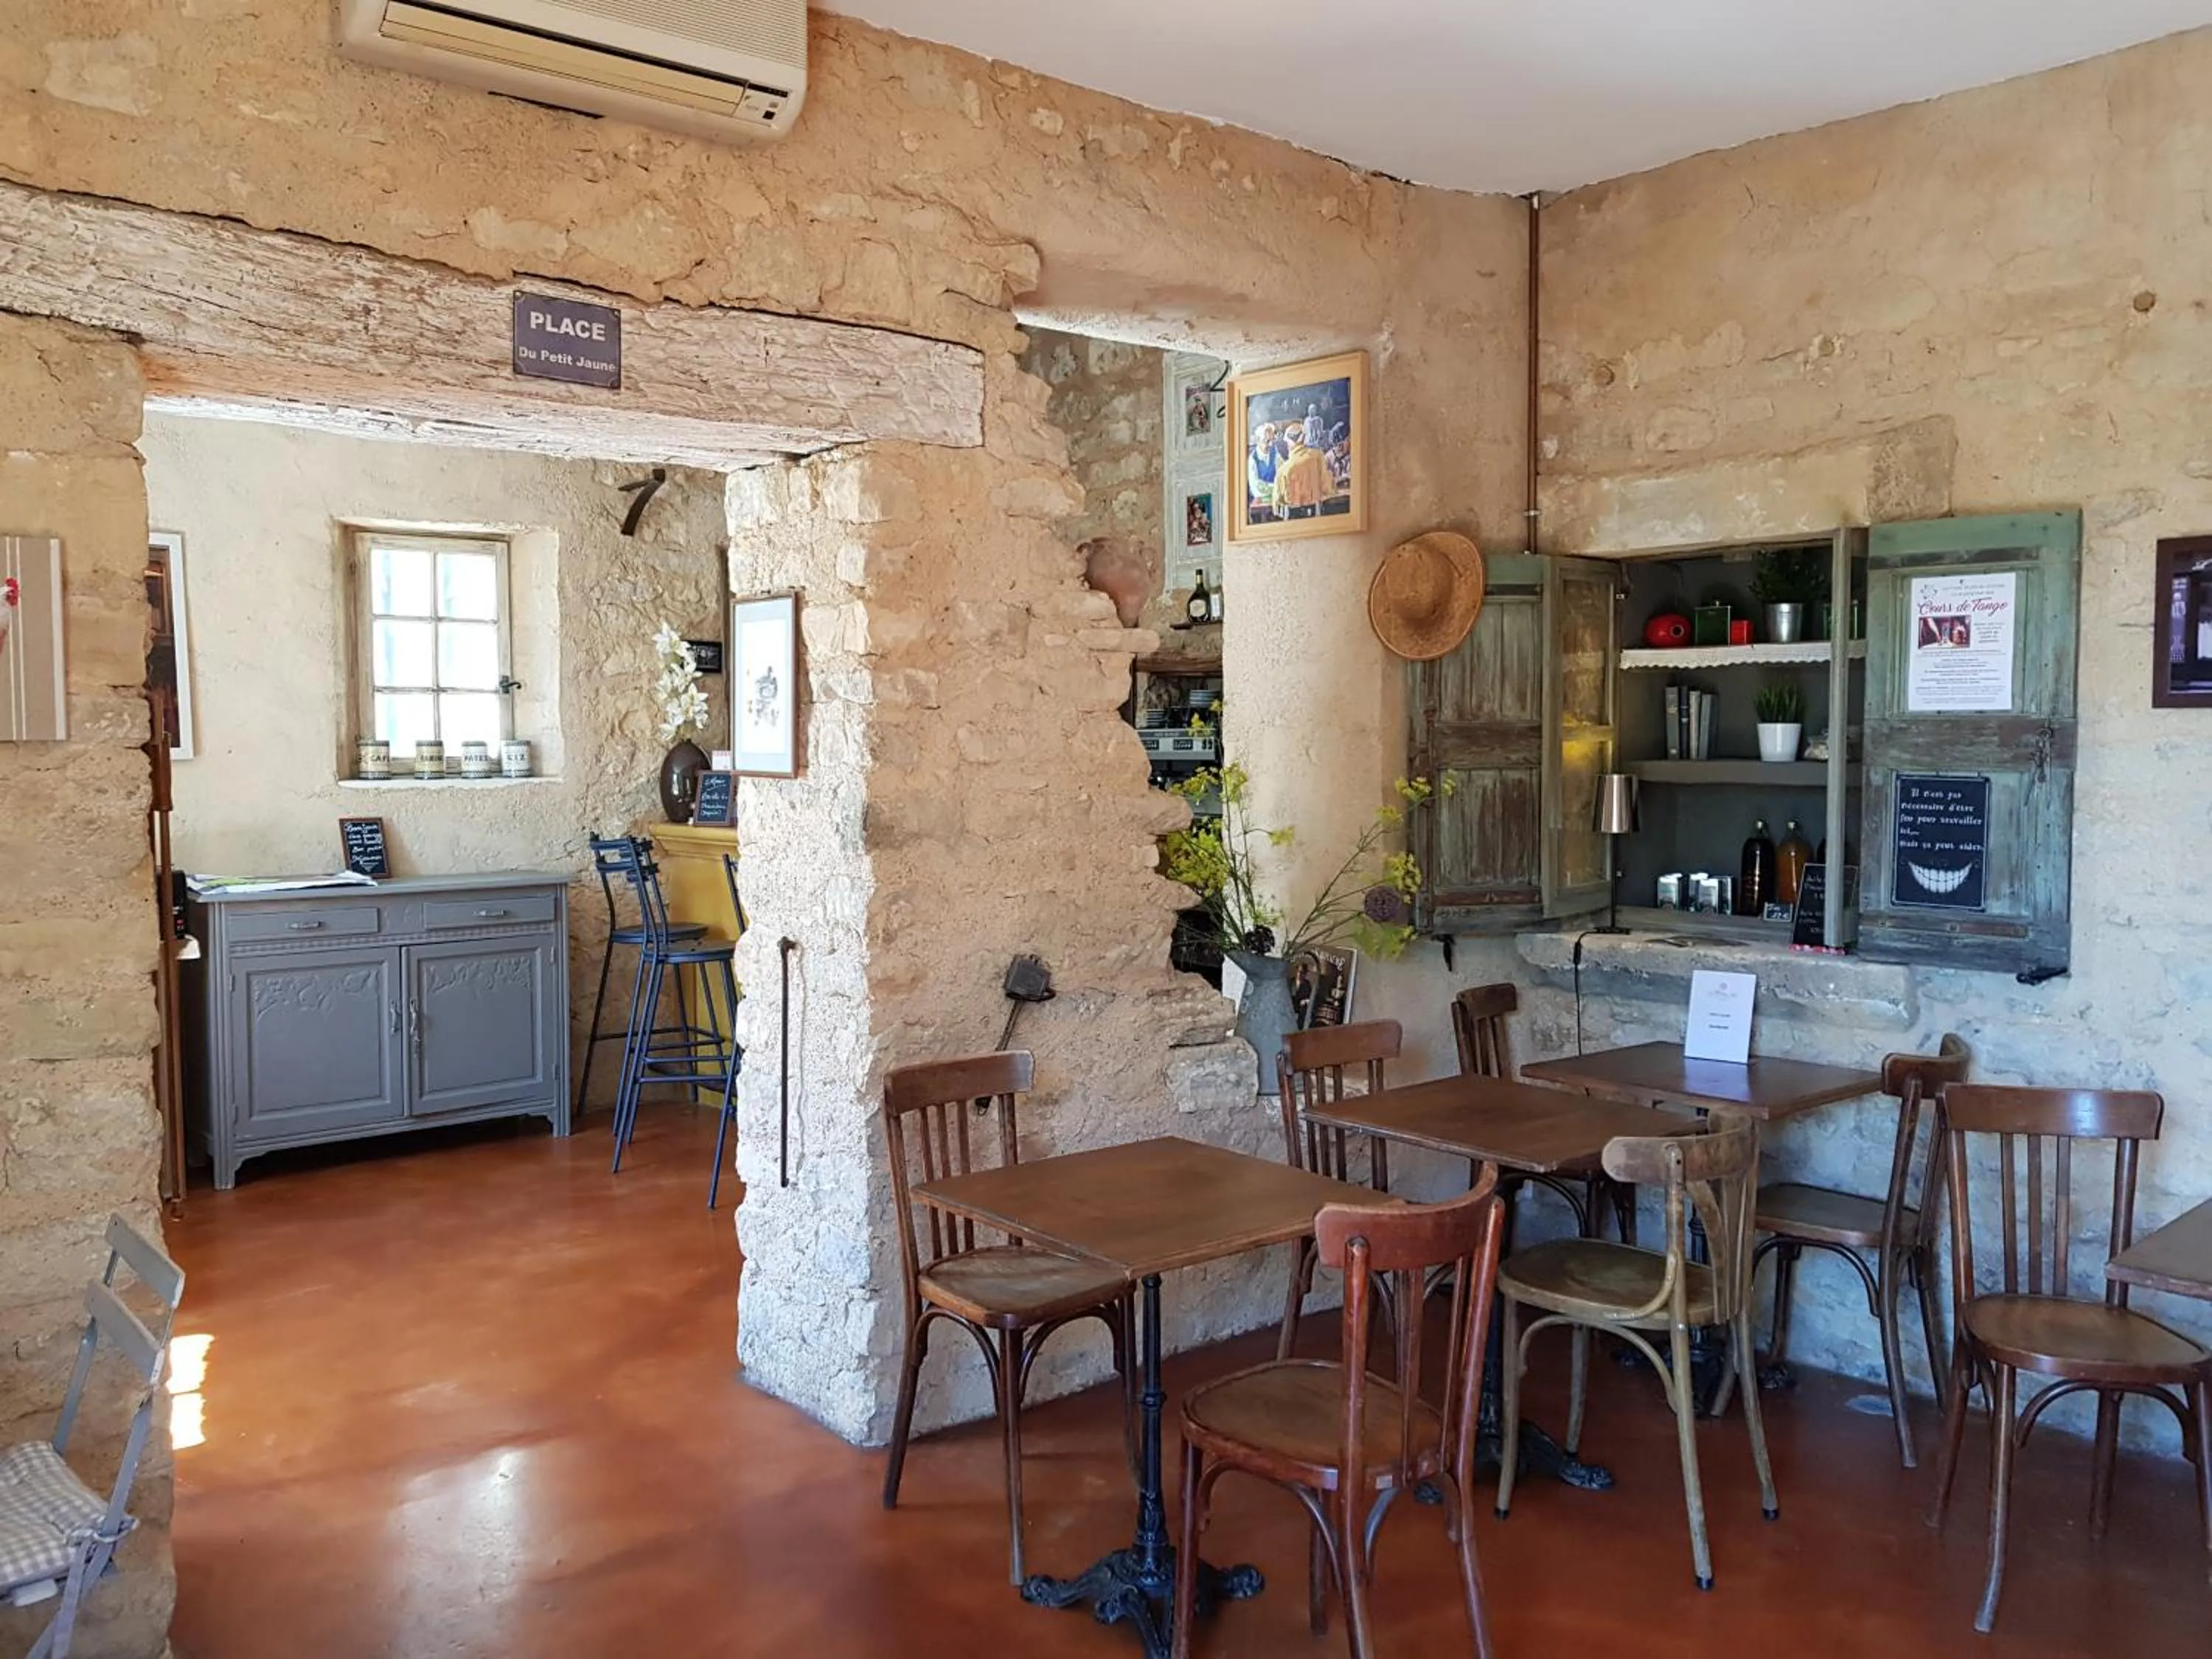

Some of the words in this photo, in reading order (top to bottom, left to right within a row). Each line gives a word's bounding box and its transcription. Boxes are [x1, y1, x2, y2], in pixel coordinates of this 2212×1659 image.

[529, 311, 605, 341] PLACE
[519, 347, 536, 359] Du
[541, 350, 572, 365] Petit
[577, 356, 616, 372] Jaune
[1918, 599, 1952, 615] Cours
[1956, 599, 1969, 612] de
[1972, 597, 2008, 616] Tango
[1911, 787, 1919, 797] Il
[1947, 791, 1962, 800] pas
[1900, 813, 1913, 823] fou
[1917, 815, 1937, 825] pour
[1940, 815, 1982, 825] travailler
[1935, 842, 1955, 851] peut
